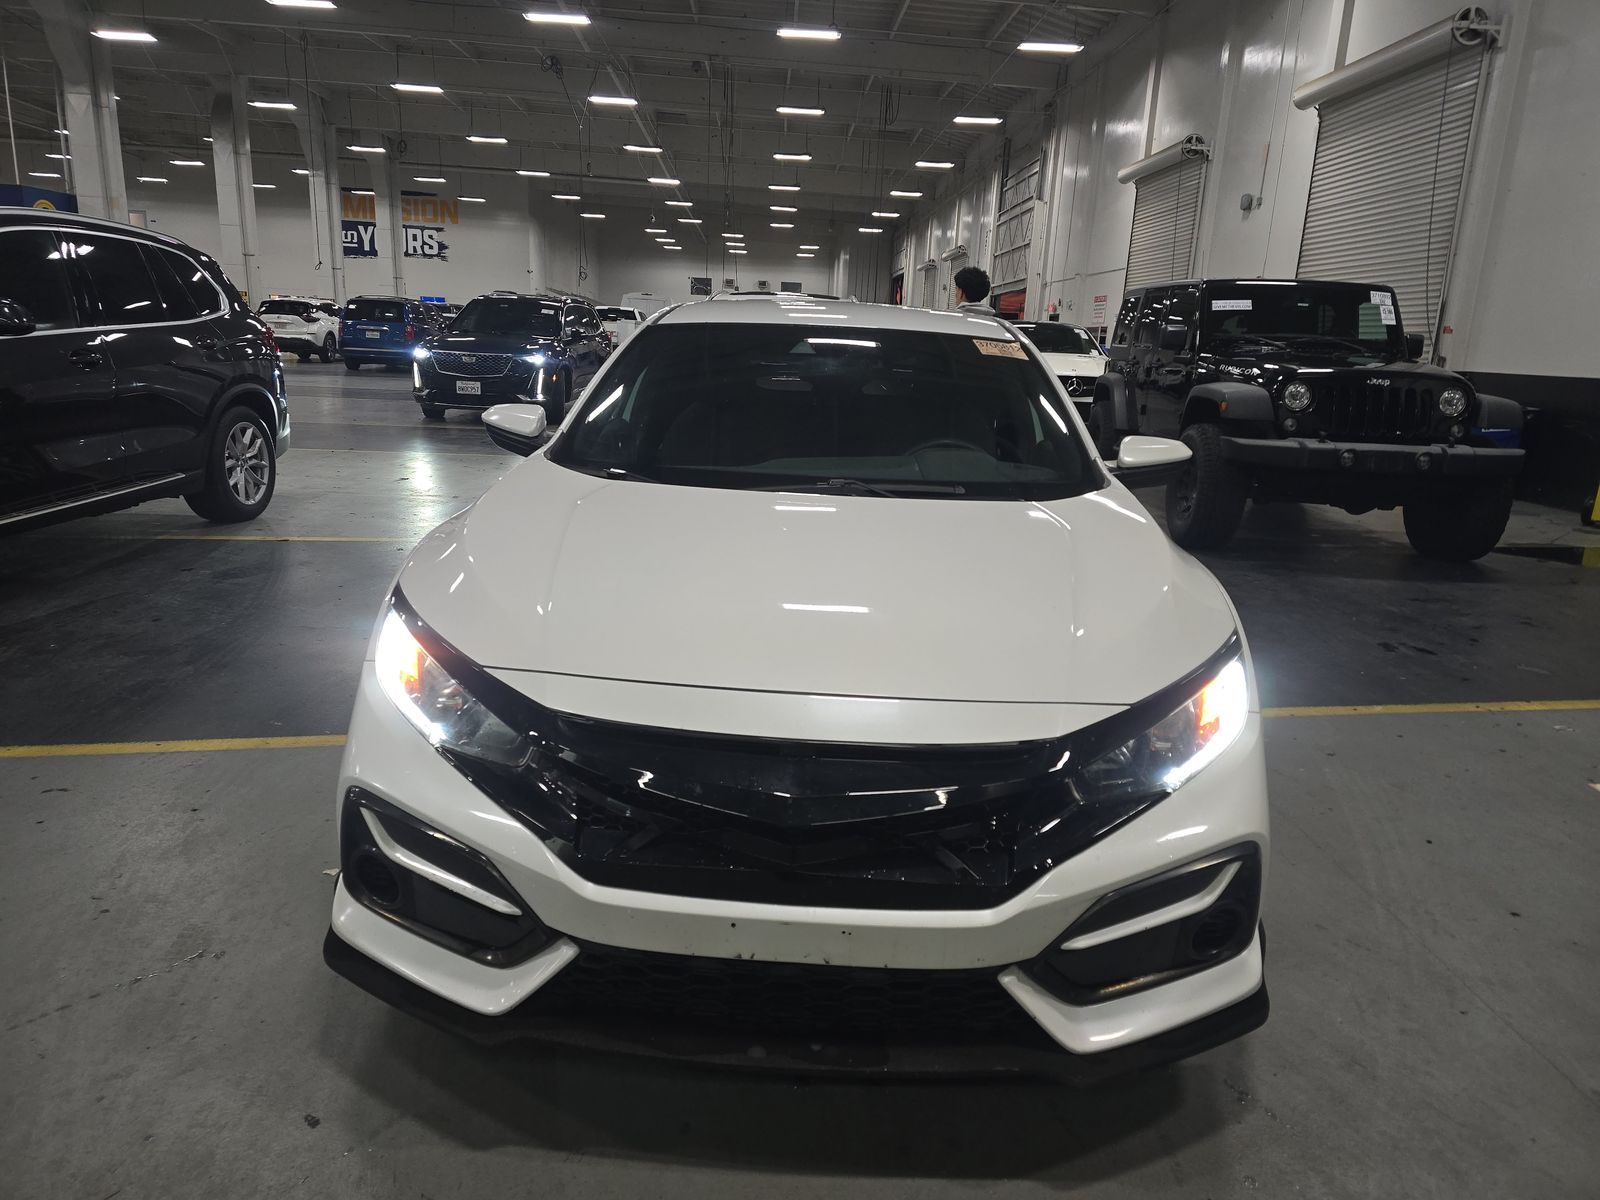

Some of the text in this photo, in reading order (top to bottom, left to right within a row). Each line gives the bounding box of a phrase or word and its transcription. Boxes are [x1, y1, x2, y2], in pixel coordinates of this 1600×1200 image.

[343, 192, 459, 225] MISION
[357, 225, 440, 255] YRS
[1219, 363, 1261, 376] RUBICON
